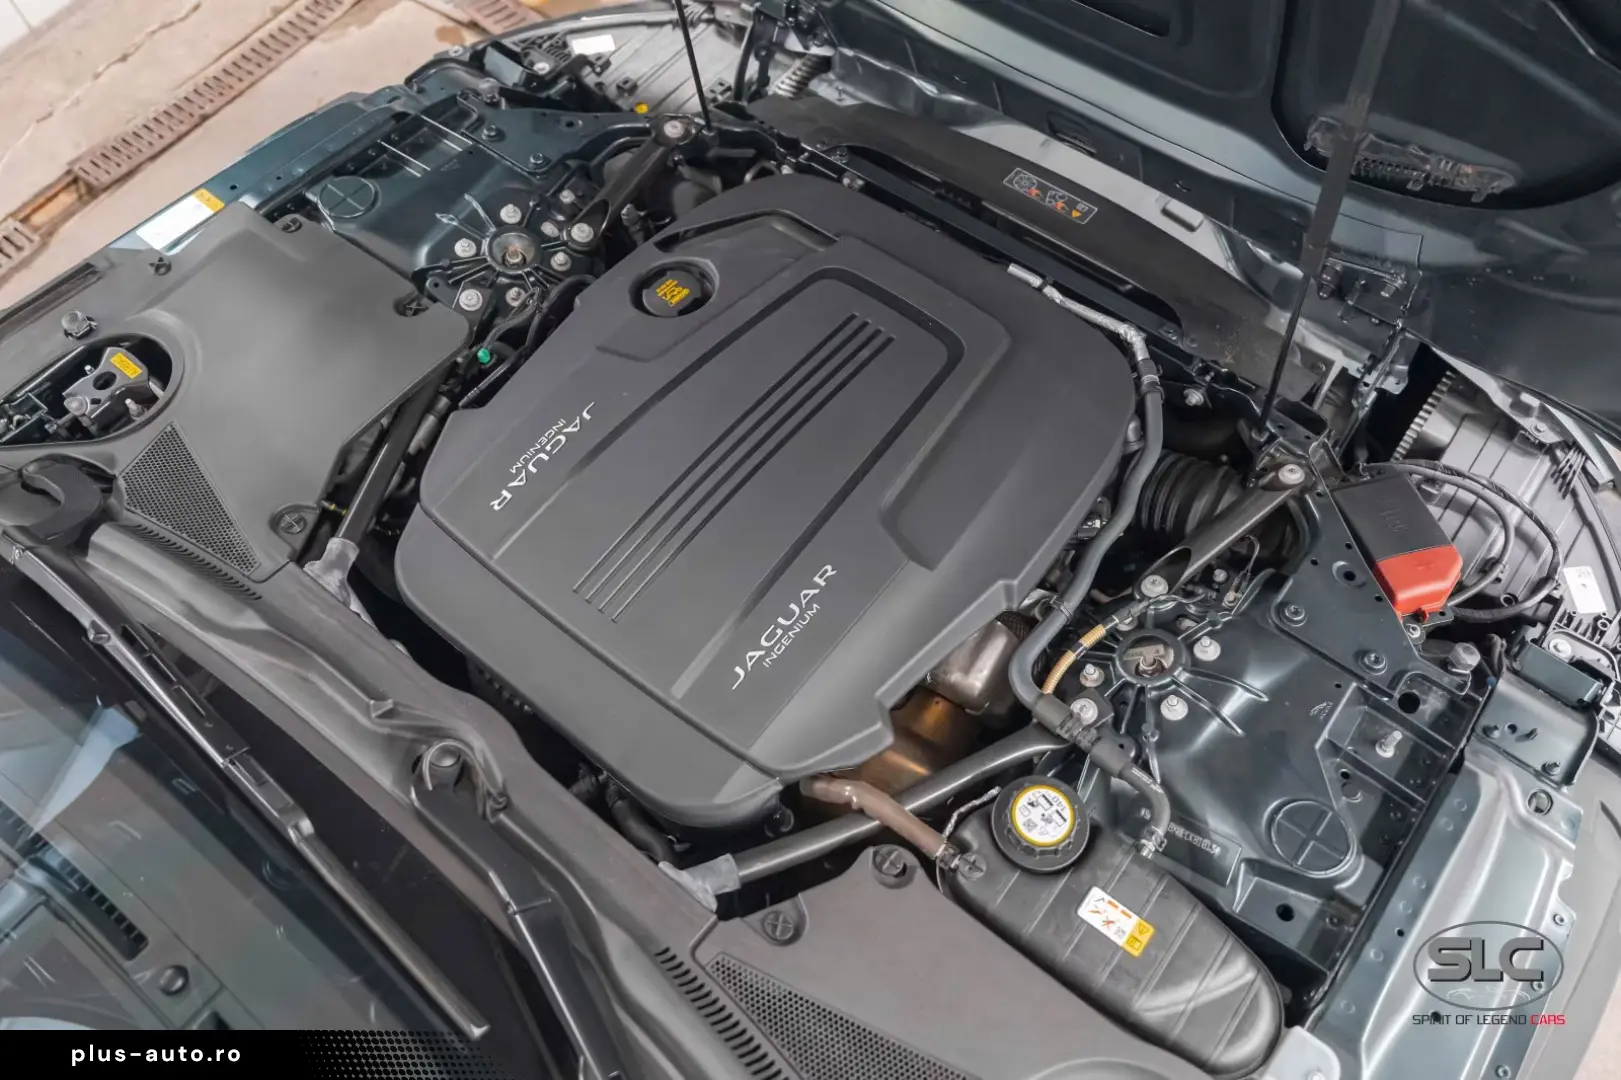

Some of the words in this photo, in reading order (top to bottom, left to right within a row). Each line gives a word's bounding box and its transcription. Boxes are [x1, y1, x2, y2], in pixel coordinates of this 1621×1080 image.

[489, 402, 595, 511] JAGUAR
[509, 418, 567, 474] INGENIUM
[731, 564, 838, 690] JAGUAR
[762, 603, 821, 668] INGENIUM
